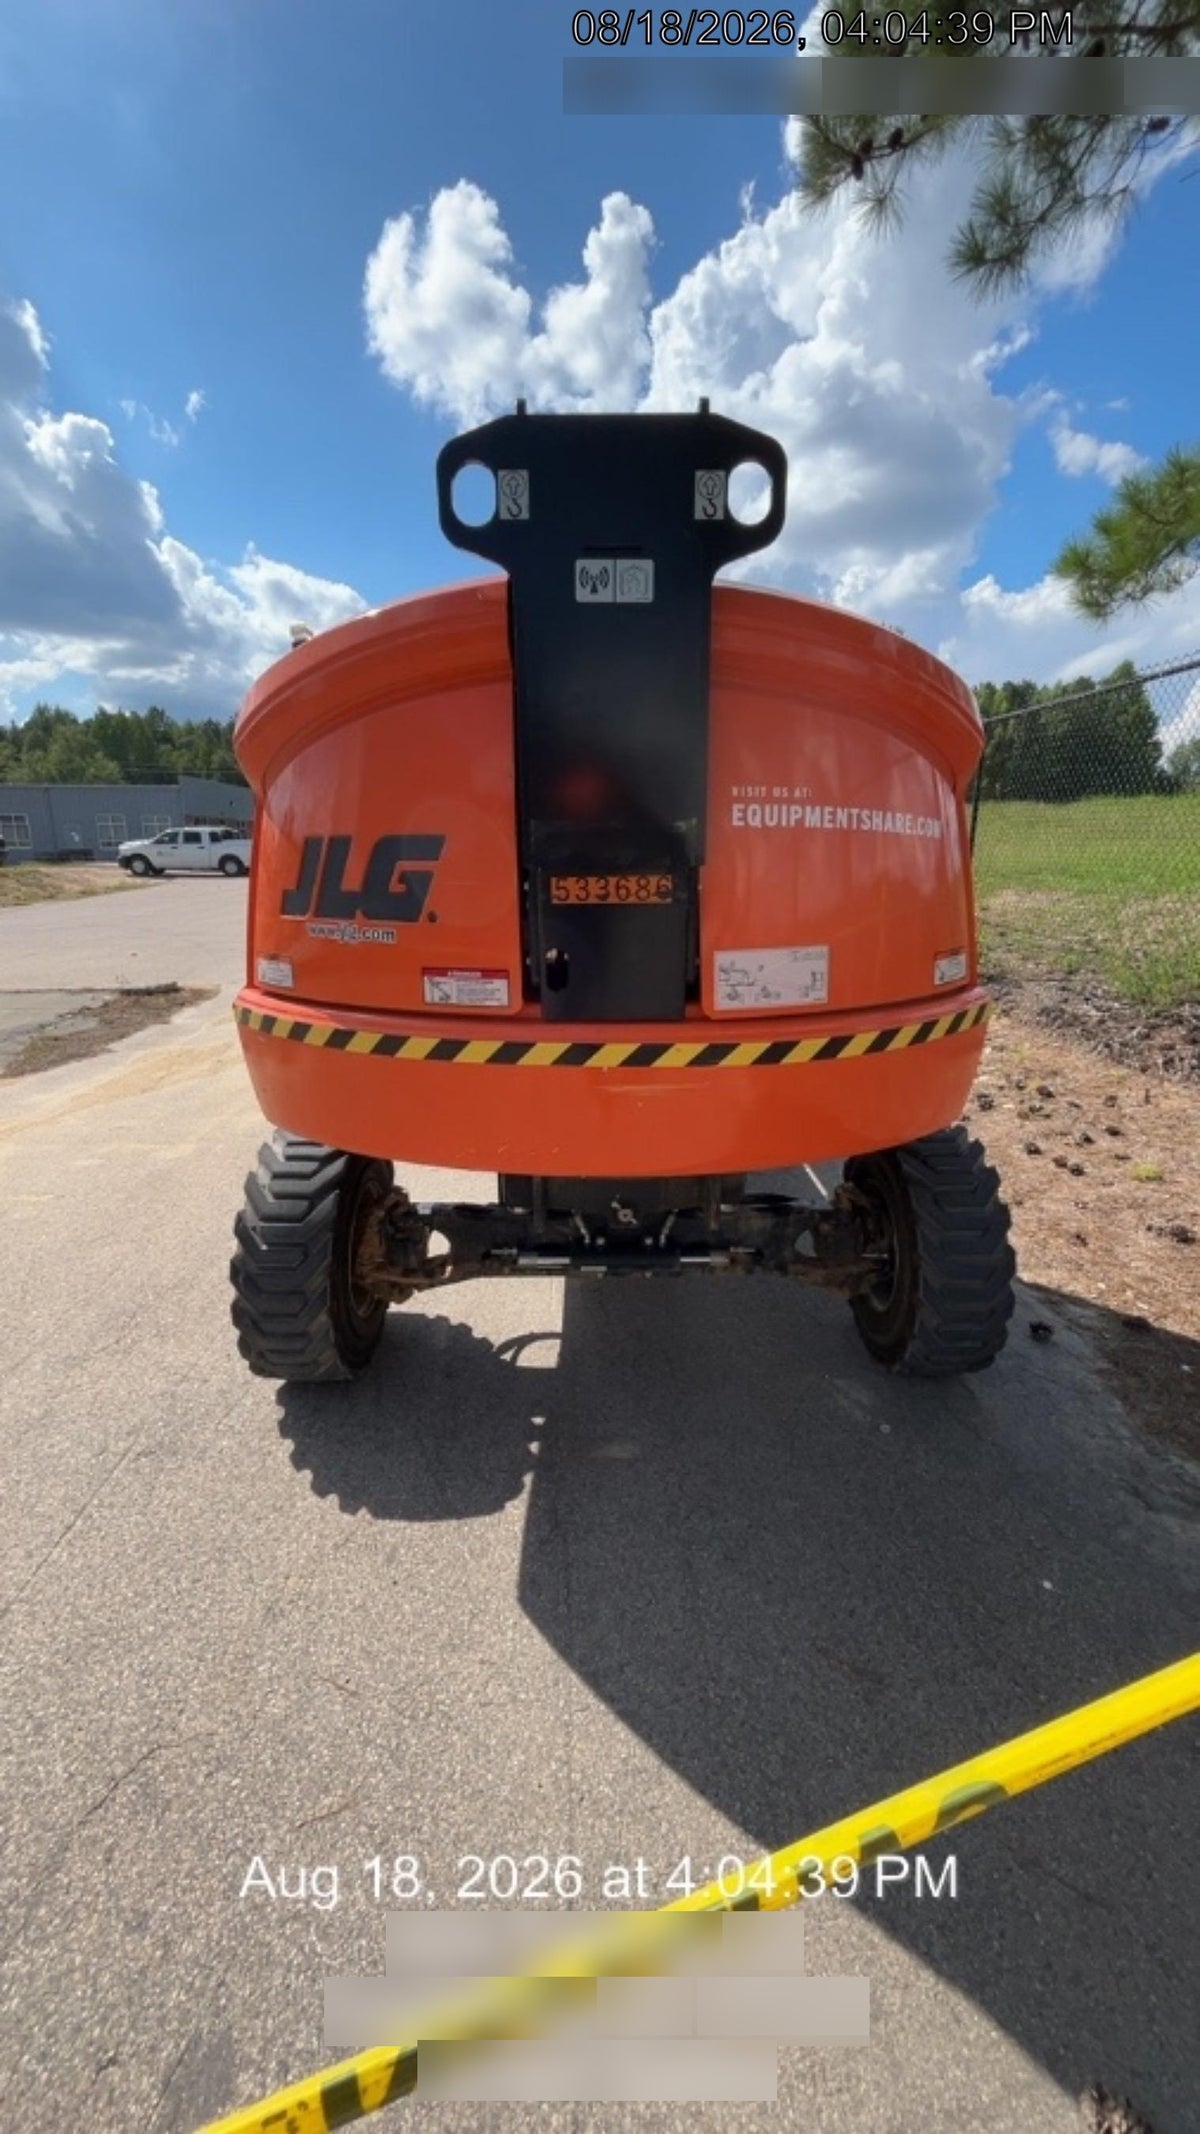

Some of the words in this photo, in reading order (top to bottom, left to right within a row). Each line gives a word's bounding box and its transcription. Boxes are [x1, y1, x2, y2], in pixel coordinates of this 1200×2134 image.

[731, 803, 942, 838] EQUIPMENTSHARE.COM
[281, 834, 446, 923] JLG
[553, 875, 672, 902] 533686
